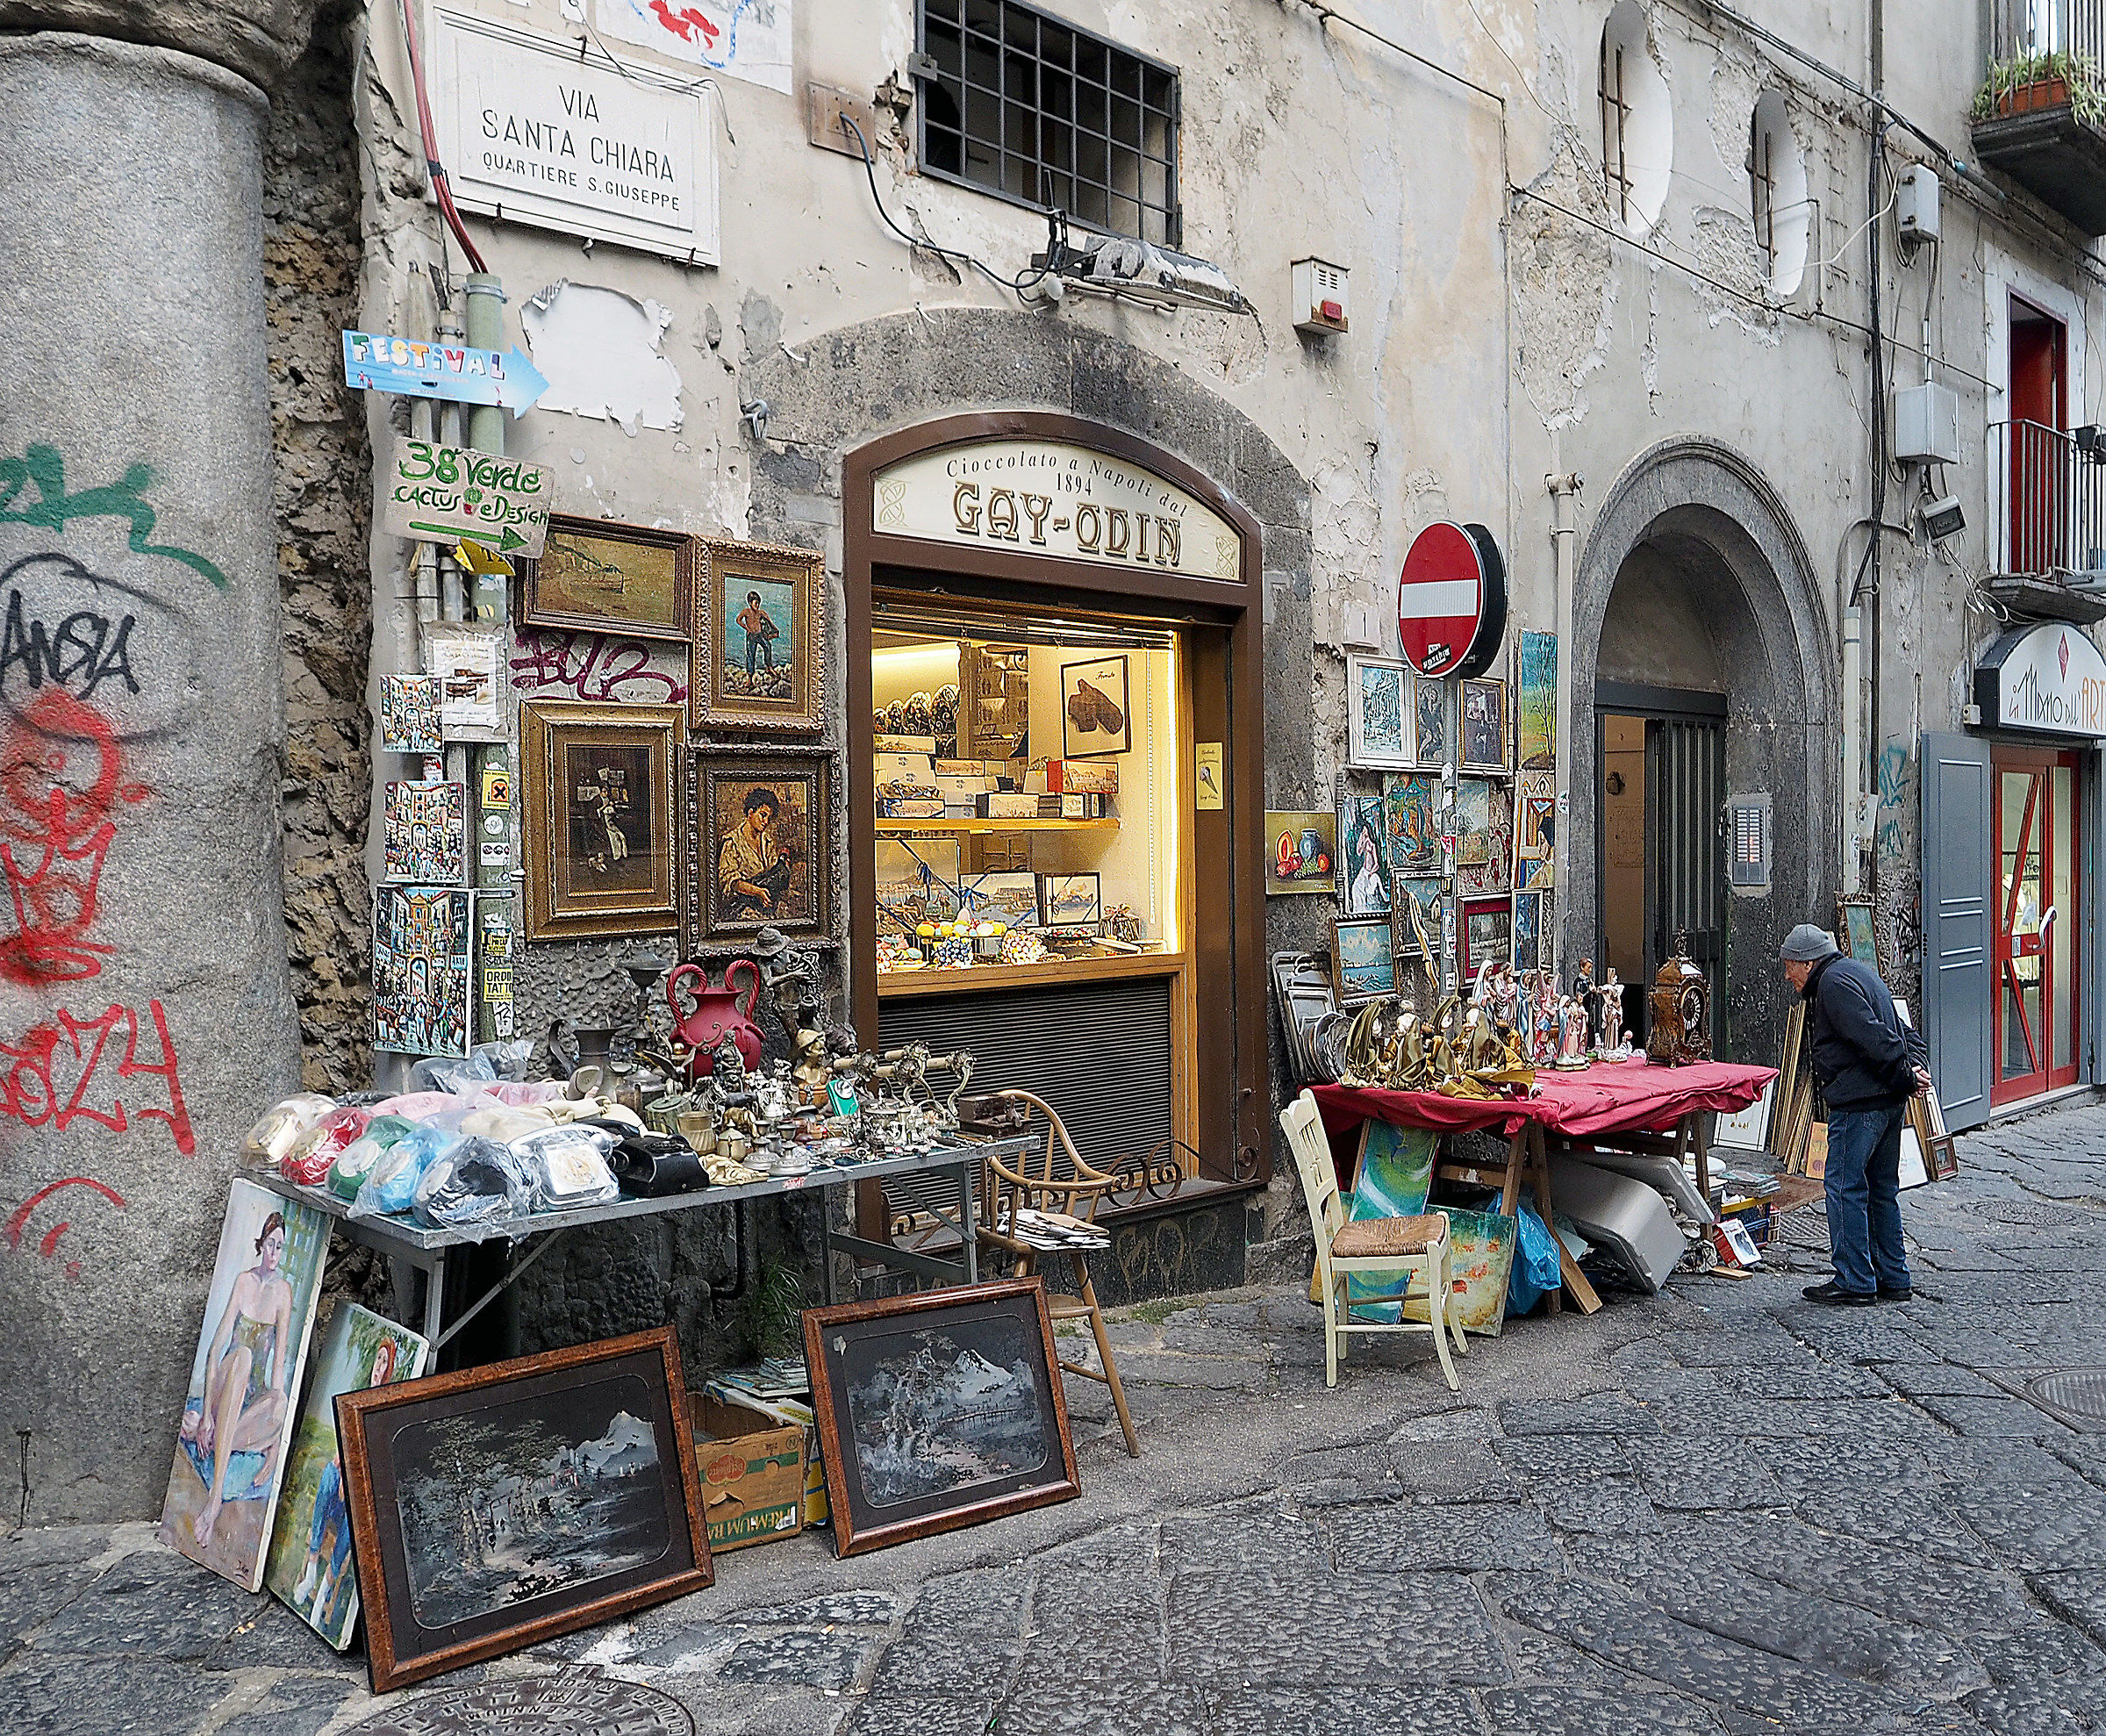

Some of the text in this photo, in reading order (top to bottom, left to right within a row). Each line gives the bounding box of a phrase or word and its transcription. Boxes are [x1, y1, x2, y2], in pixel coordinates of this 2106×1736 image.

[559, 84, 599, 124] VIA
[482, 109, 675, 183] SANTA CHIARA
[483, 151, 577, 187] QUARTIERE
[946, 450, 1188, 519] Cioccolato a Napoli dal
[1056, 471, 1092, 497] 1894
[953, 480, 1182, 567] GAY-ODIN
[537, 1679, 618, 1691] NAPOLI
[467, 1704, 605, 1724] MILLENNIUM
